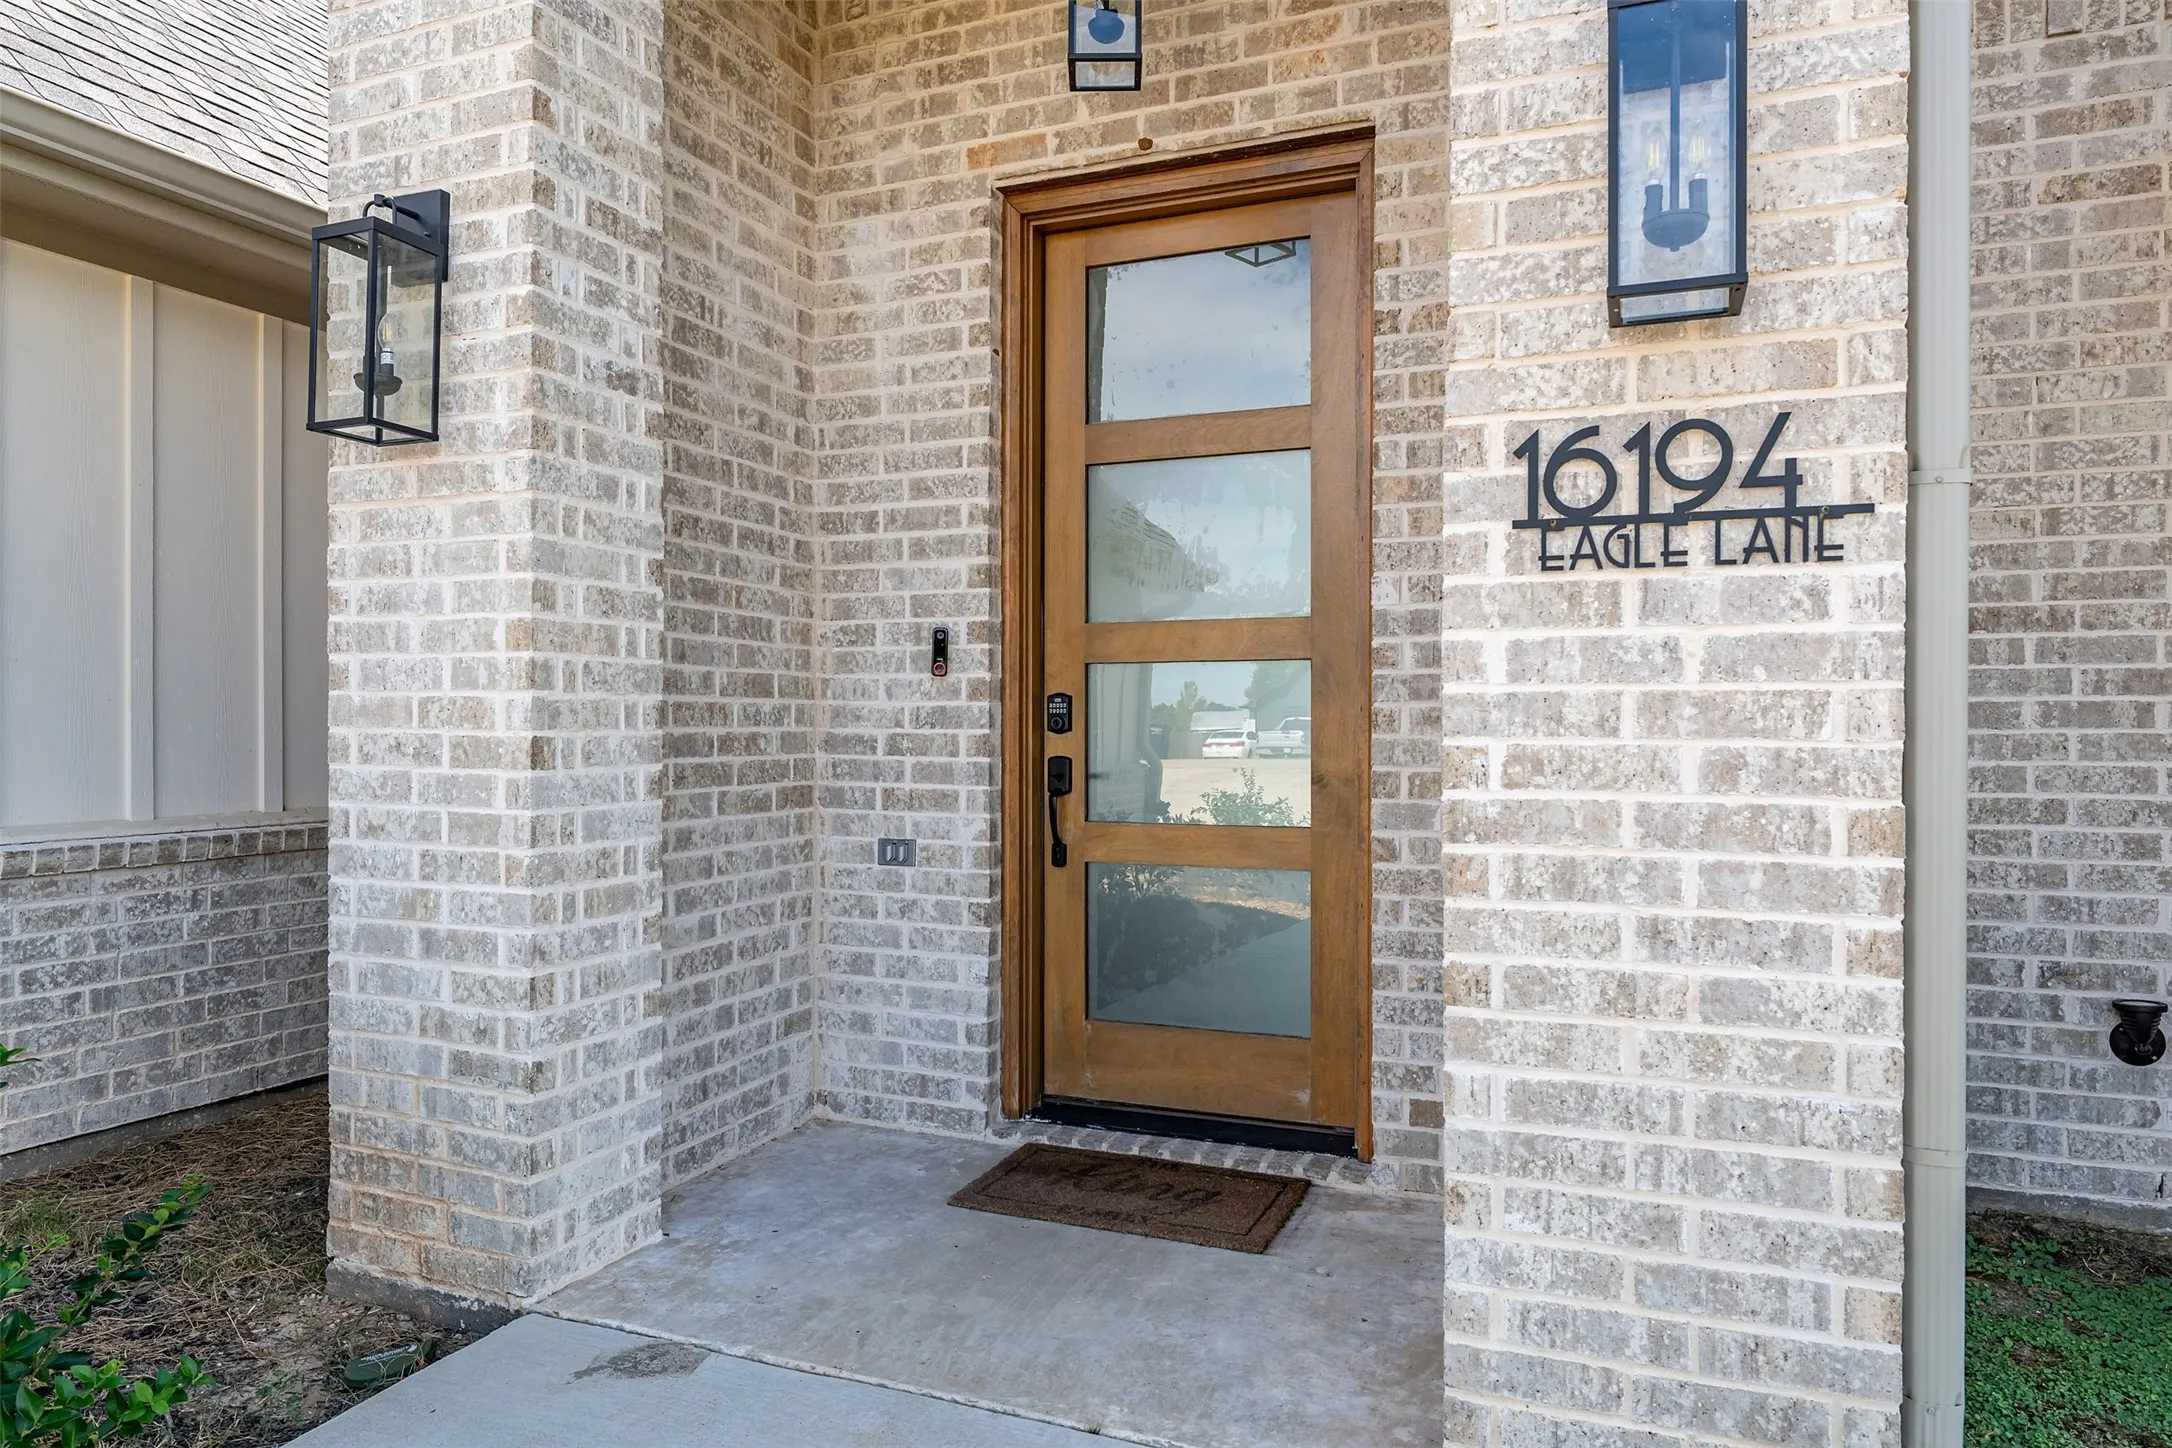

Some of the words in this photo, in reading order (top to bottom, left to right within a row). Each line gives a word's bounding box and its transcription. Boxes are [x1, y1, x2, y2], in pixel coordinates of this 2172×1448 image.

[1512, 411, 1804, 520] 16194
[1538, 520, 1689, 571] EAGLE
[1714, 514, 1845, 565] LANE
